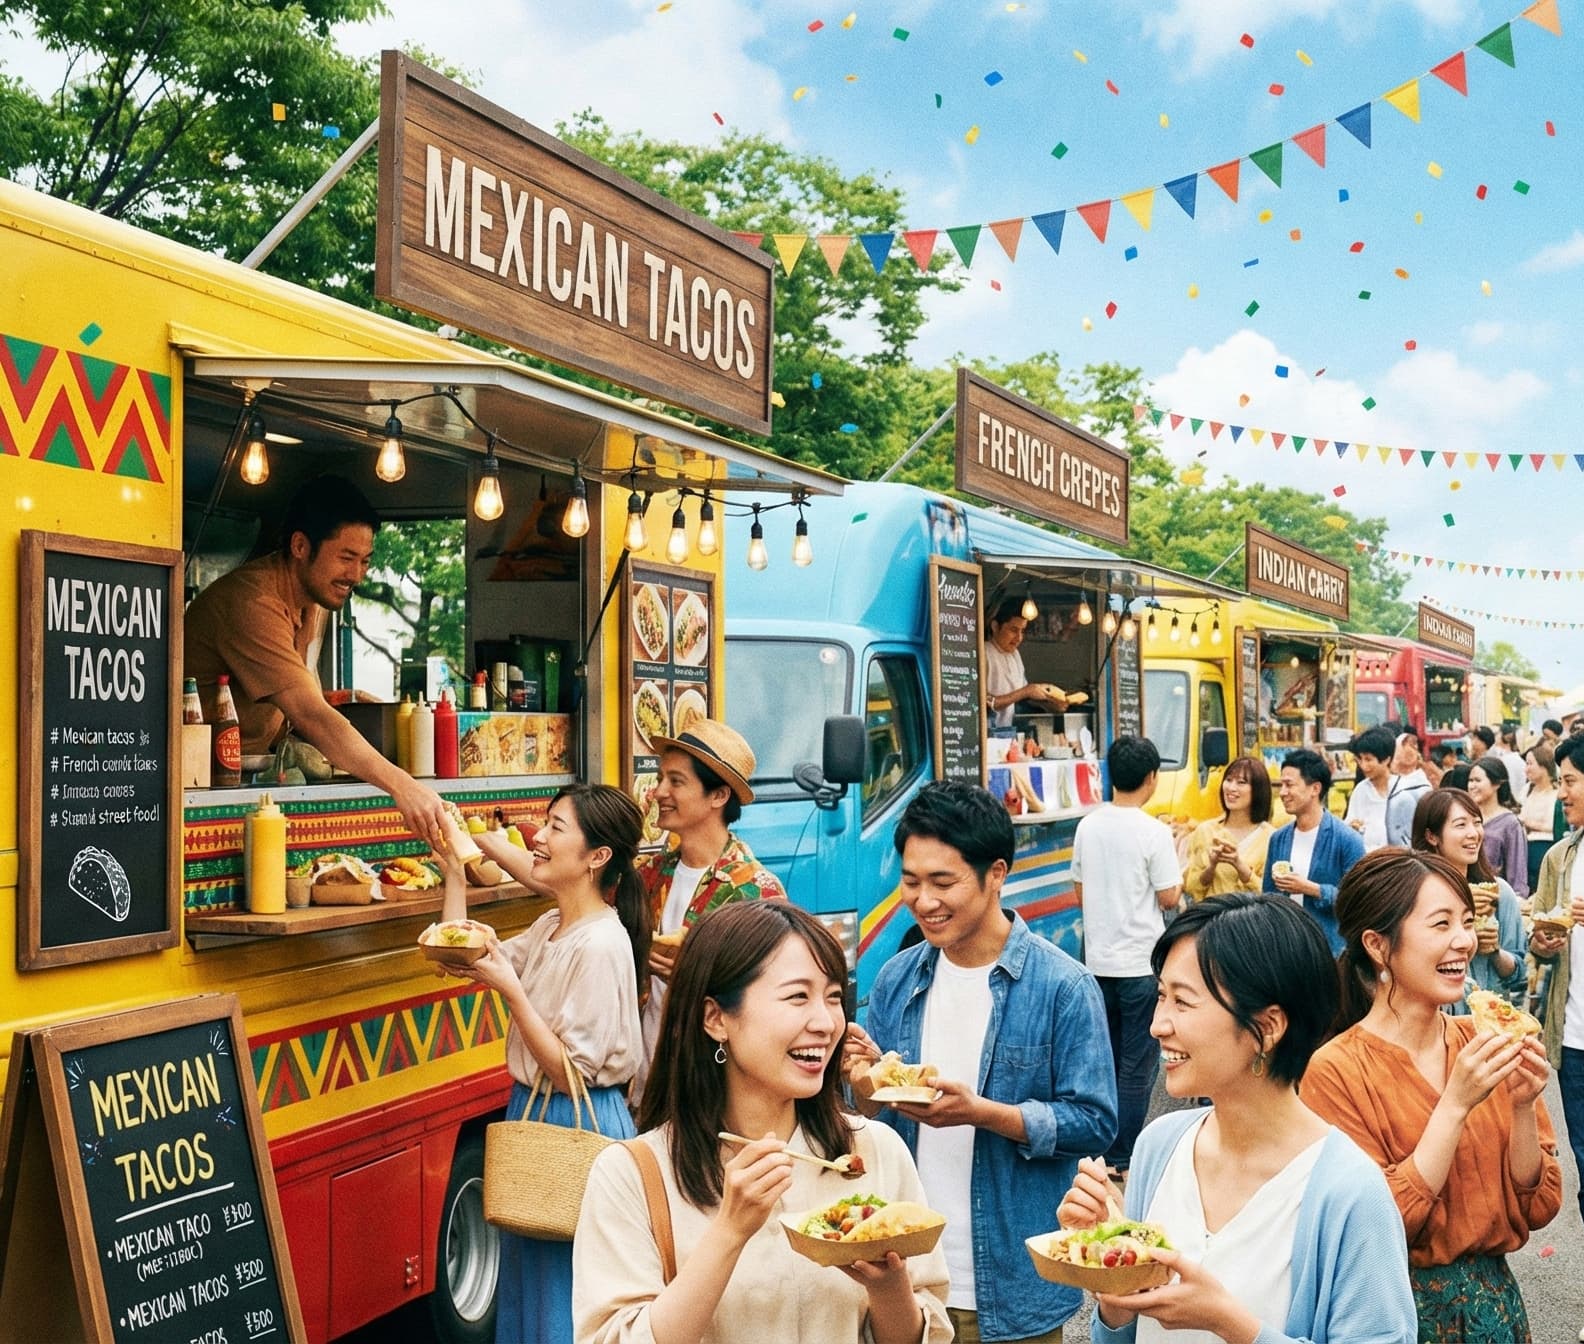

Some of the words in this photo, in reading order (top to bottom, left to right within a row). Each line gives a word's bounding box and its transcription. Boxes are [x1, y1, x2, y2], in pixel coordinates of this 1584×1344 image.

[425, 144, 629, 329] MEXICAN
[643, 251, 756, 379] TACOS
[978, 411, 1054, 492] FRENCH
[1059, 451, 1121, 518] CREPES
[1258, 546, 1306, 594] INDIAN
[47, 576, 162, 639] MEXICAN
[64, 645, 146, 703] TACOS
[63, 753, 99, 772] French
[99, 807, 132, 824] street
[89, 1053, 221, 1137] MEXICAN
[114, 1132, 215, 1202] TACOS
[115, 1222, 175, 1263] MEXICAN
[176, 1213, 211, 1242] TACO
[127, 1288, 187, 1331] MEXICAN
[188, 1274, 230, 1307] TACOS
